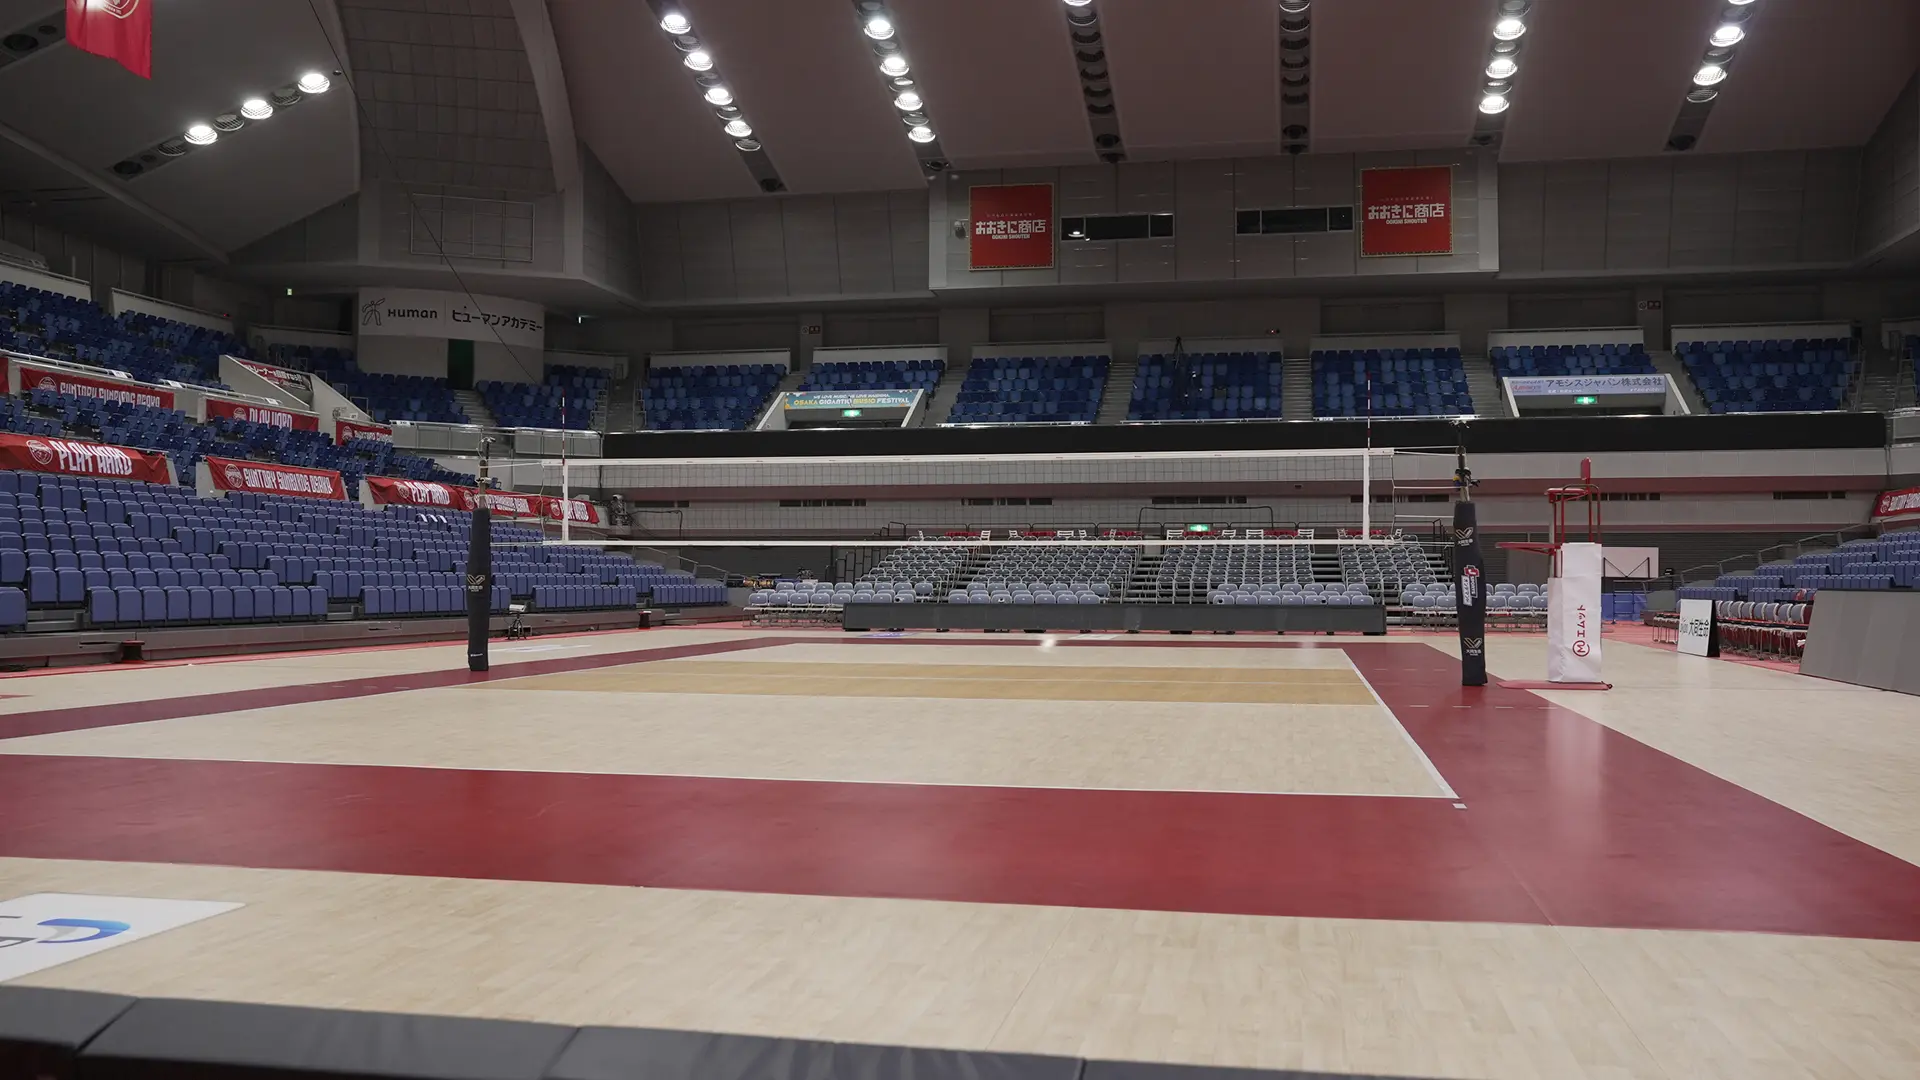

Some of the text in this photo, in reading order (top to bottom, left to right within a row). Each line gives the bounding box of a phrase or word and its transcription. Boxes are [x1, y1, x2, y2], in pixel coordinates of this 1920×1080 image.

[1367, 203, 1445, 219] おおきに商店
[976, 219, 1047, 235] おおきに商店
[452, 309, 543, 332] ヒューマンアカデミー
[1545, 376, 1663, 388] アモシスジャパン株式会社
[49, 440, 133, 476] PLAY HARD
[243, 468, 278, 490] SUNTORY
[404, 481, 430, 503] PLAY
